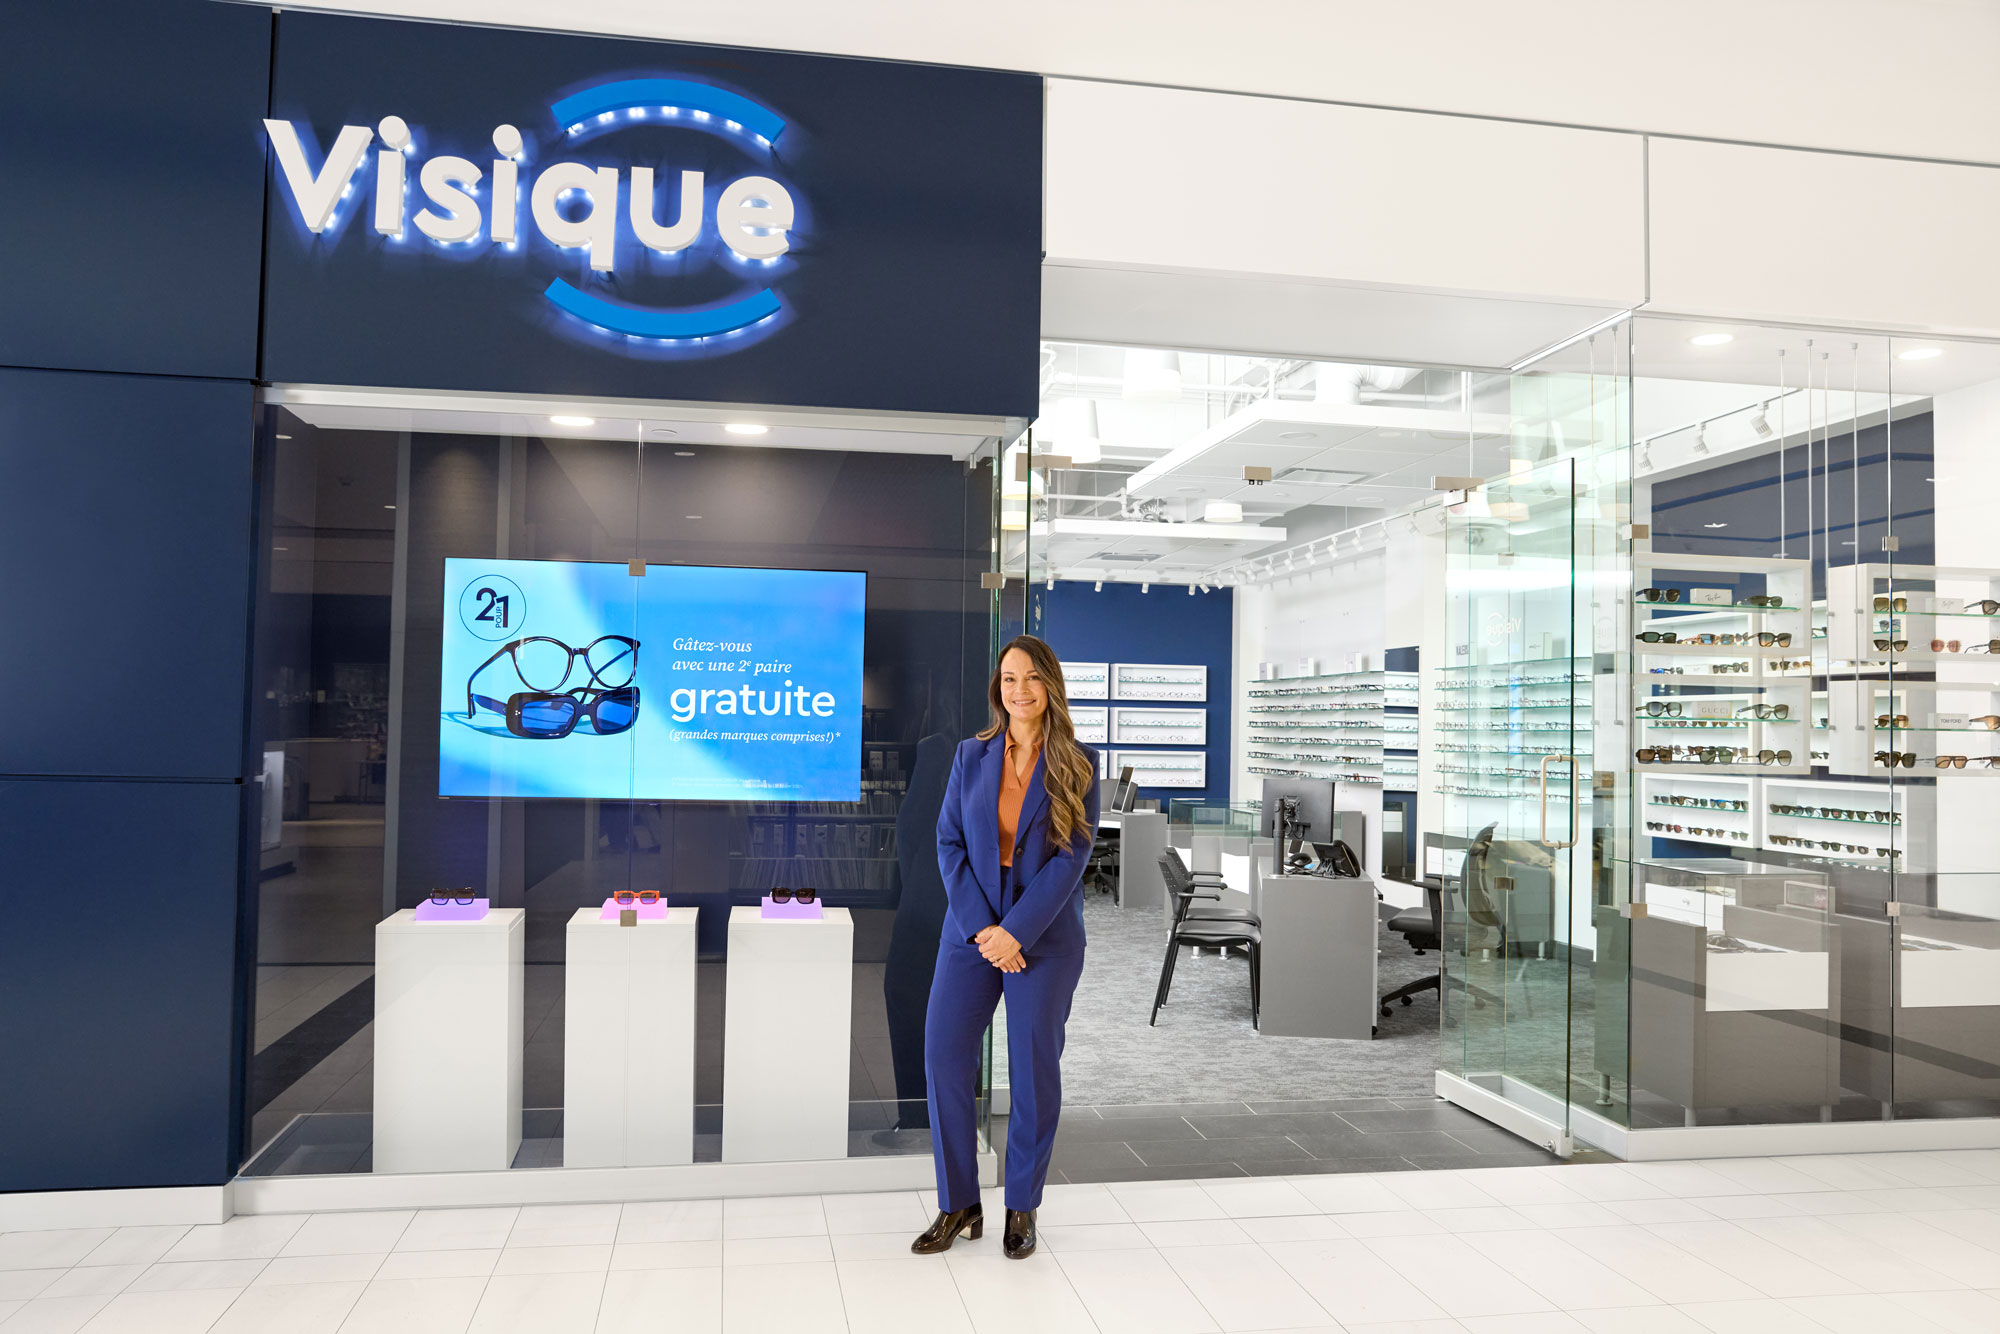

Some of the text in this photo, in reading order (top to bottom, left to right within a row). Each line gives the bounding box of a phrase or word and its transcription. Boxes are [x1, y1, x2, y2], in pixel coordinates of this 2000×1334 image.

[262, 115, 795, 273] Visique
[495, 606, 503, 629] POUR
[672, 637, 753, 653] Gâtez-vous
[672, 660, 704, 671] avec
[708, 661, 735, 672] une
[753, 659, 792, 677] paire
[669, 679, 836, 723] gratuite
[1701, 706, 1730, 714] GUCCI
[669, 728, 719, 742] (grandes
[721, 731, 769, 745] marques
